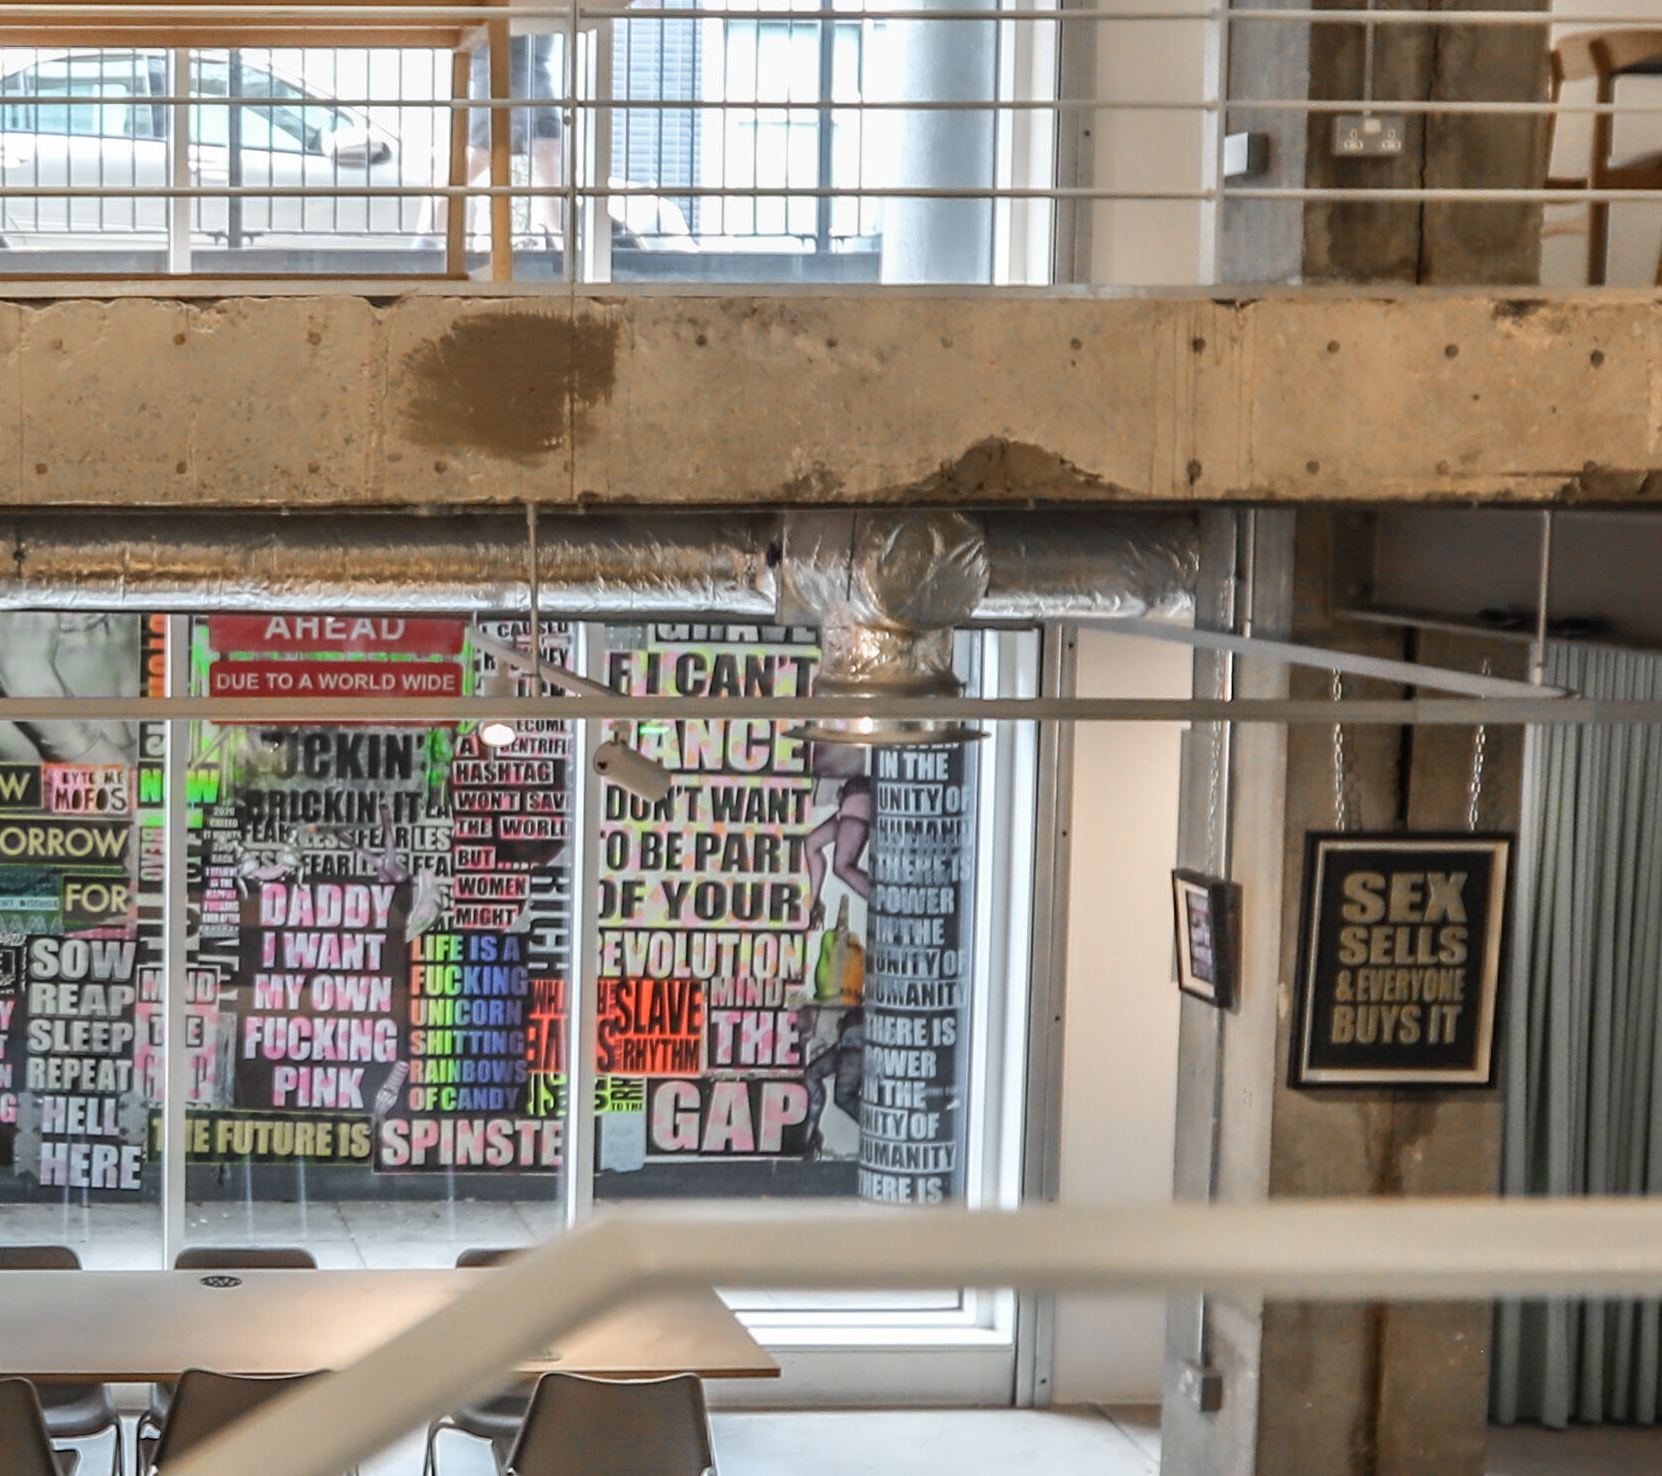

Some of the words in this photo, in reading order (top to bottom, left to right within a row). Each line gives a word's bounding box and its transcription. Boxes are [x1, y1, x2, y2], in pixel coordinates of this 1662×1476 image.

[264, 615, 406, 641] AHEAD
[216, 674, 259, 691] DUE
[266, 674, 293, 691] TO
[298, 674, 314, 690] A
[318, 673, 397, 691] WORLD
[401, 674, 456, 692] WIDE
[675, 652, 819, 697] CAN'T
[455, 761, 552, 783] HASHTAG
[878, 751, 899, 779] IN
[903, 752, 949, 781] THE
[54, 787, 128, 812] MOFOS
[393, 791, 425, 823] IT
[457, 791, 519, 811] WON'T
[711, 787, 812, 823] WANT
[879, 786, 941, 813] UNITY
[456, 819, 491, 838] THE
[639, 831, 684, 872] BE
[695, 833, 806, 874] PART
[64, 883, 128, 913] FOR
[457, 876, 528, 898] WOMEN
[660, 880, 802, 923] YOUR
[877, 885, 955, 915] POWER
[1341, 871, 1469, 924] SEX
[259, 881, 397, 929] DADDY
[455, 907, 517, 926] MIGHT
[30, 937, 137, 981] SOW
[262, 931, 276, 968] I
[283, 931, 387, 970] WANT
[409, 933, 464, 962] LIFE
[469, 934, 498, 963] IS
[502, 935, 521, 961] A
[599, 929, 806, 979] EVOLUTION
[1338, 926, 1469, 966] SELLS
[253, 973, 306, 1011] MY
[311, 974, 393, 1012] OWN
[409, 964, 529, 997] FUCKING
[710, 976, 785, 1008] MIND
[1356, 968, 1466, 1002] EVERYONE
[29, 982, 136, 1017] REAP
[409, 998, 523, 1027] UNICORN
[615, 978, 702, 1036] SLAVE
[28, 1018, 134, 1054] SLEEP
[243, 1015, 398, 1063] FUCKING
[710, 1010, 801, 1066] THE
[932, 1017, 957, 1047] IS
[1331, 1004, 1422, 1045] BUYS
[1428, 1005, 1463, 1045] IT
[409, 1029, 527, 1056] SHITTING
[623, 1037, 701, 1073] RHYTHM
[28, 1057, 133, 1092] REPEAT
[271, 1065, 365, 1109] PINK
[408, 1058, 528, 1085] RAINBOWS
[408, 1086, 440, 1112] OF
[440, 1086, 520, 1112] CANDY
[881, 1079, 927, 1109] THE
[42, 1095, 120, 1136] HELL
[651, 1080, 810, 1153] GAP
[910, 1112, 941, 1141] OF
[216, 1119, 333, 1158] FUTURE
[338, 1122, 371, 1158] IS
[380, 1118, 565, 1167] SPINSTE
[39, 1142, 143, 1191] HERE
